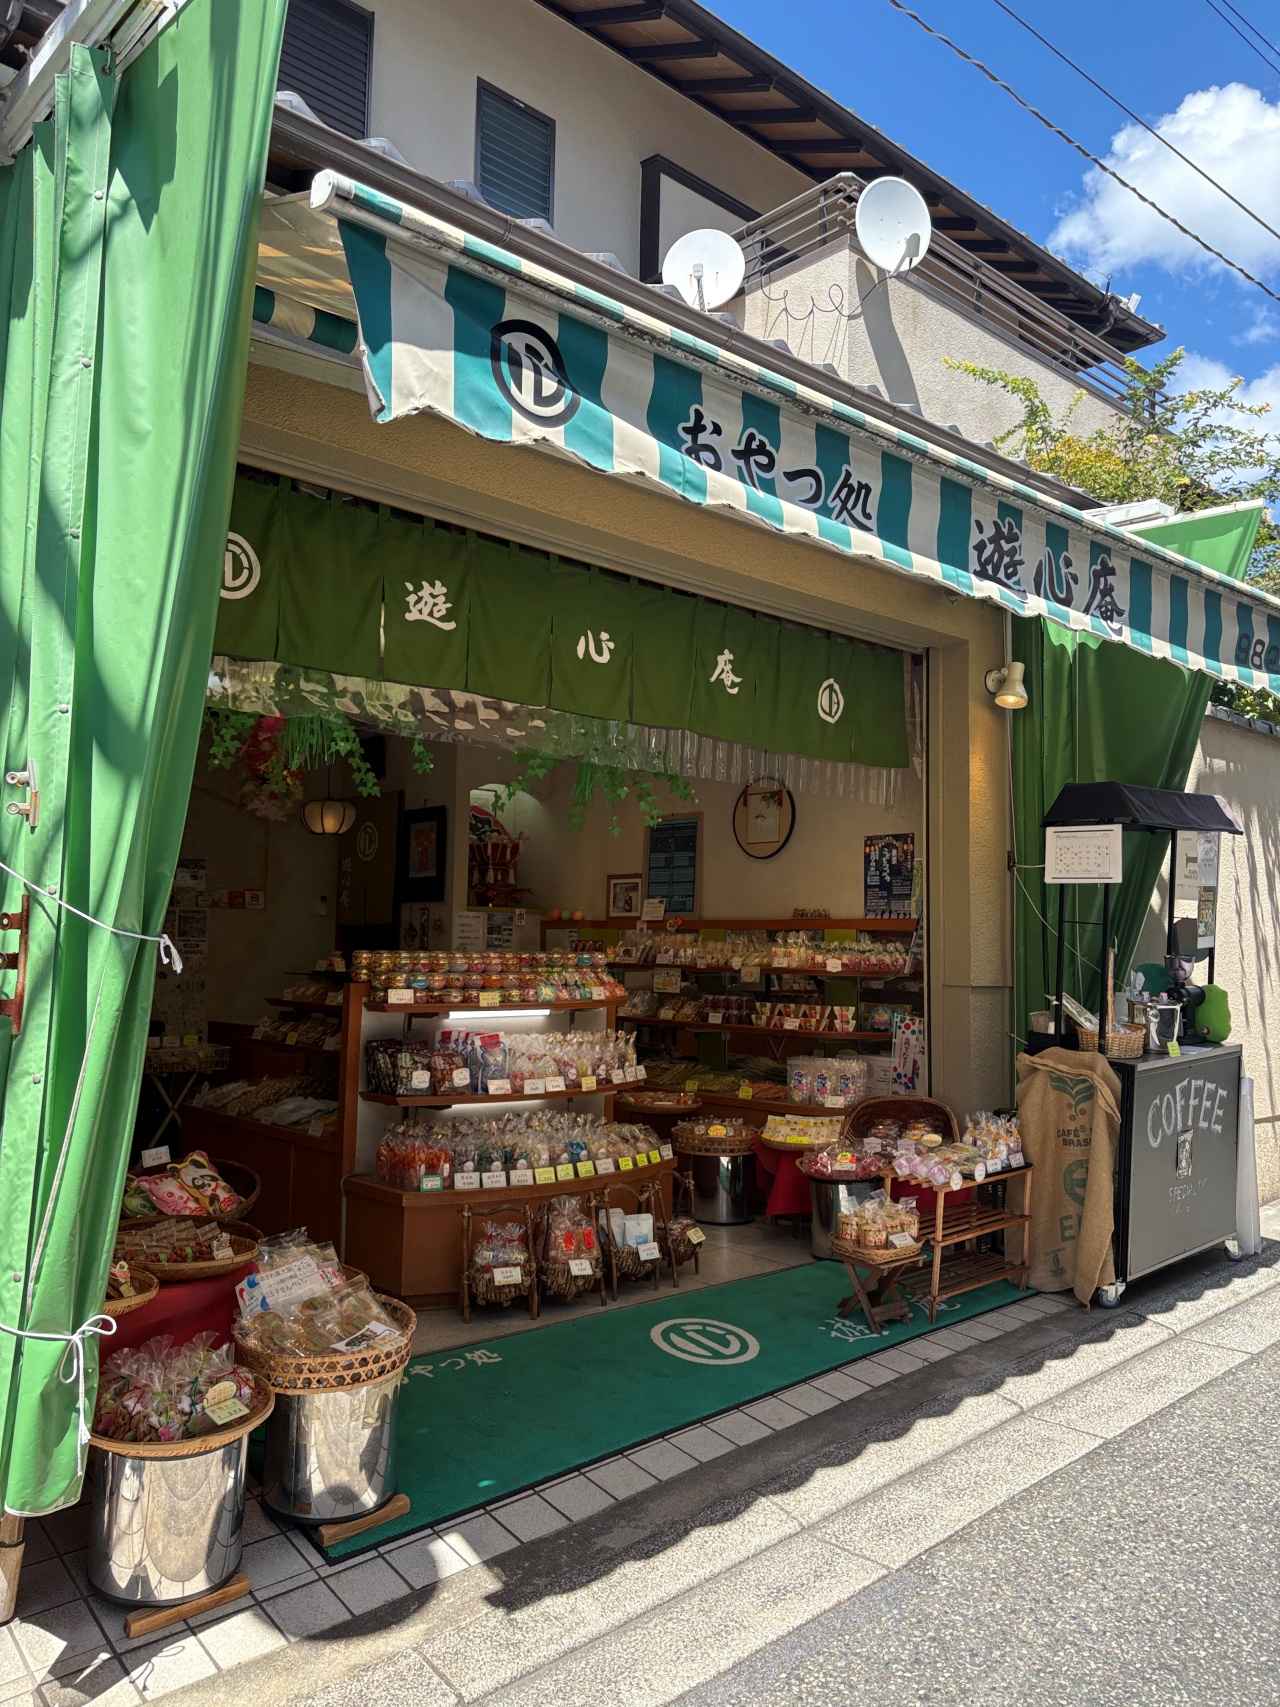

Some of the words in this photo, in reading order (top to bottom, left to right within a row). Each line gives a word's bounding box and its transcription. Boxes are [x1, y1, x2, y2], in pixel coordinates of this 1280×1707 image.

[682, 407, 875, 532] おやつ処
[972, 519, 1126, 637] 遊心庵
[576, 629, 615, 664] 心
[1147, 1078, 1228, 1148] COFFEE
[400, 1349, 503, 1385] やつ処
